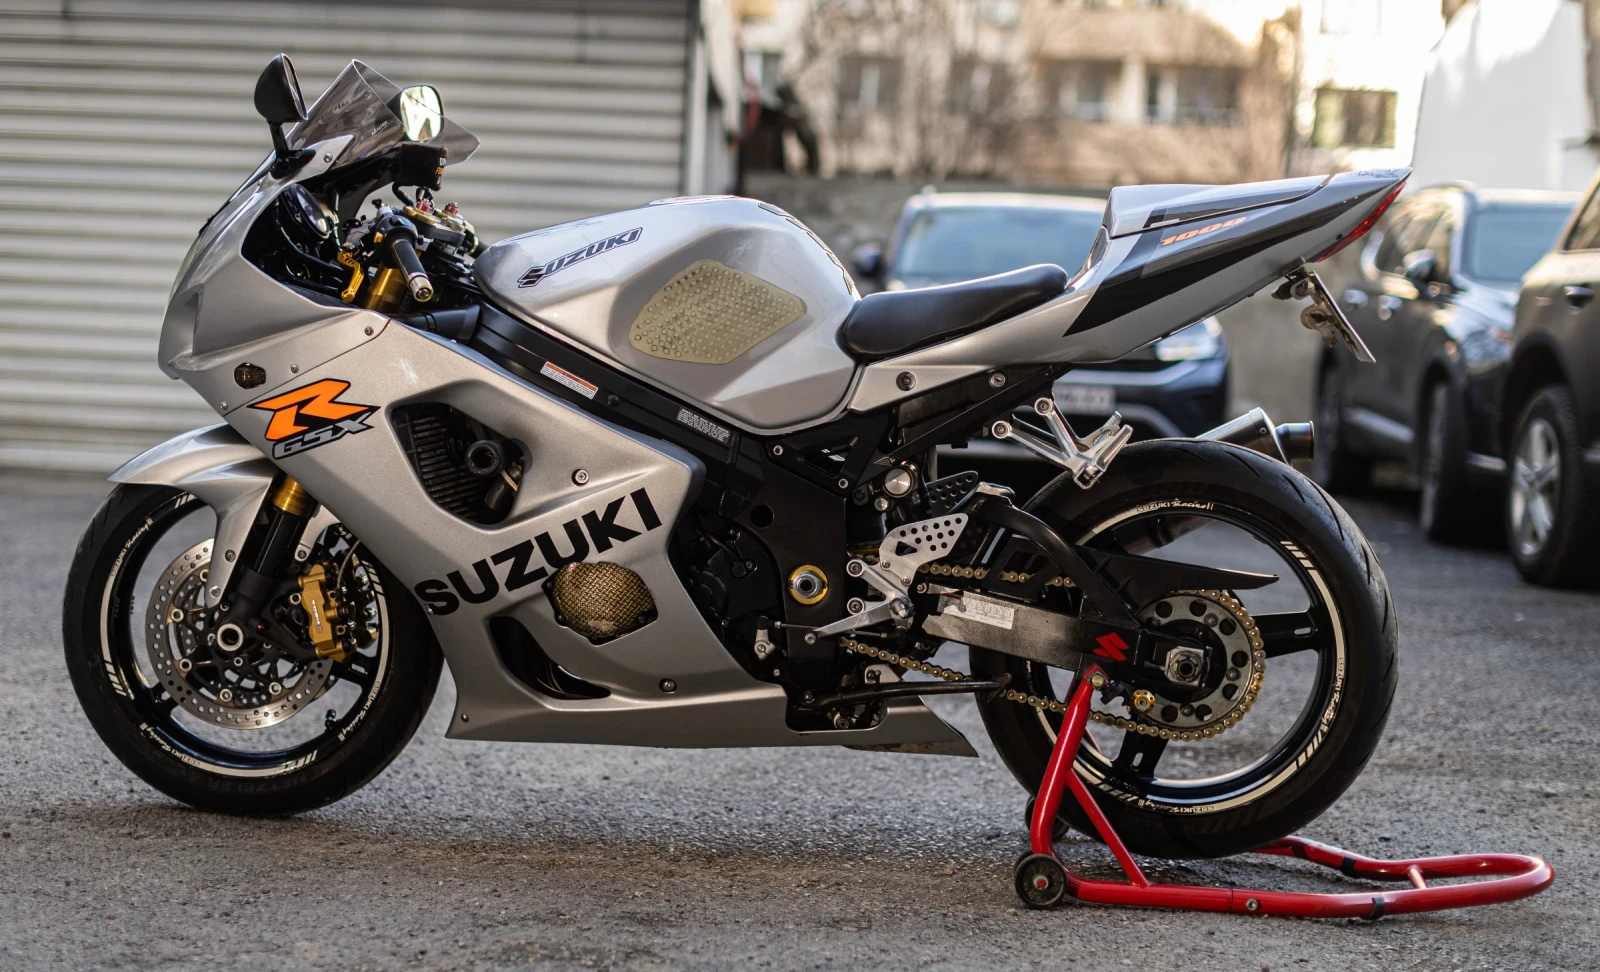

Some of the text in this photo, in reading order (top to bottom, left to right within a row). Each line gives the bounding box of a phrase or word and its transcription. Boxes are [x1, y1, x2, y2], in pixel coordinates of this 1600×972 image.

[1160, 216, 1247, 246] 1000
[518, 228, 642, 287] SUZUKI
[273, 411, 375, 459] GSX
[1136, 501, 1170, 512] SUZUKI
[110, 523, 149, 577] SUZUKI Racing
[414, 487, 662, 616] SUZUKI
[1335, 657, 1345, 691] SUZUKI
[342, 680, 381, 735] SUZUKI Racing
[146, 727, 200, 767] SUZUKI Racing
[1180, 804, 1214, 814] SUZUKI
